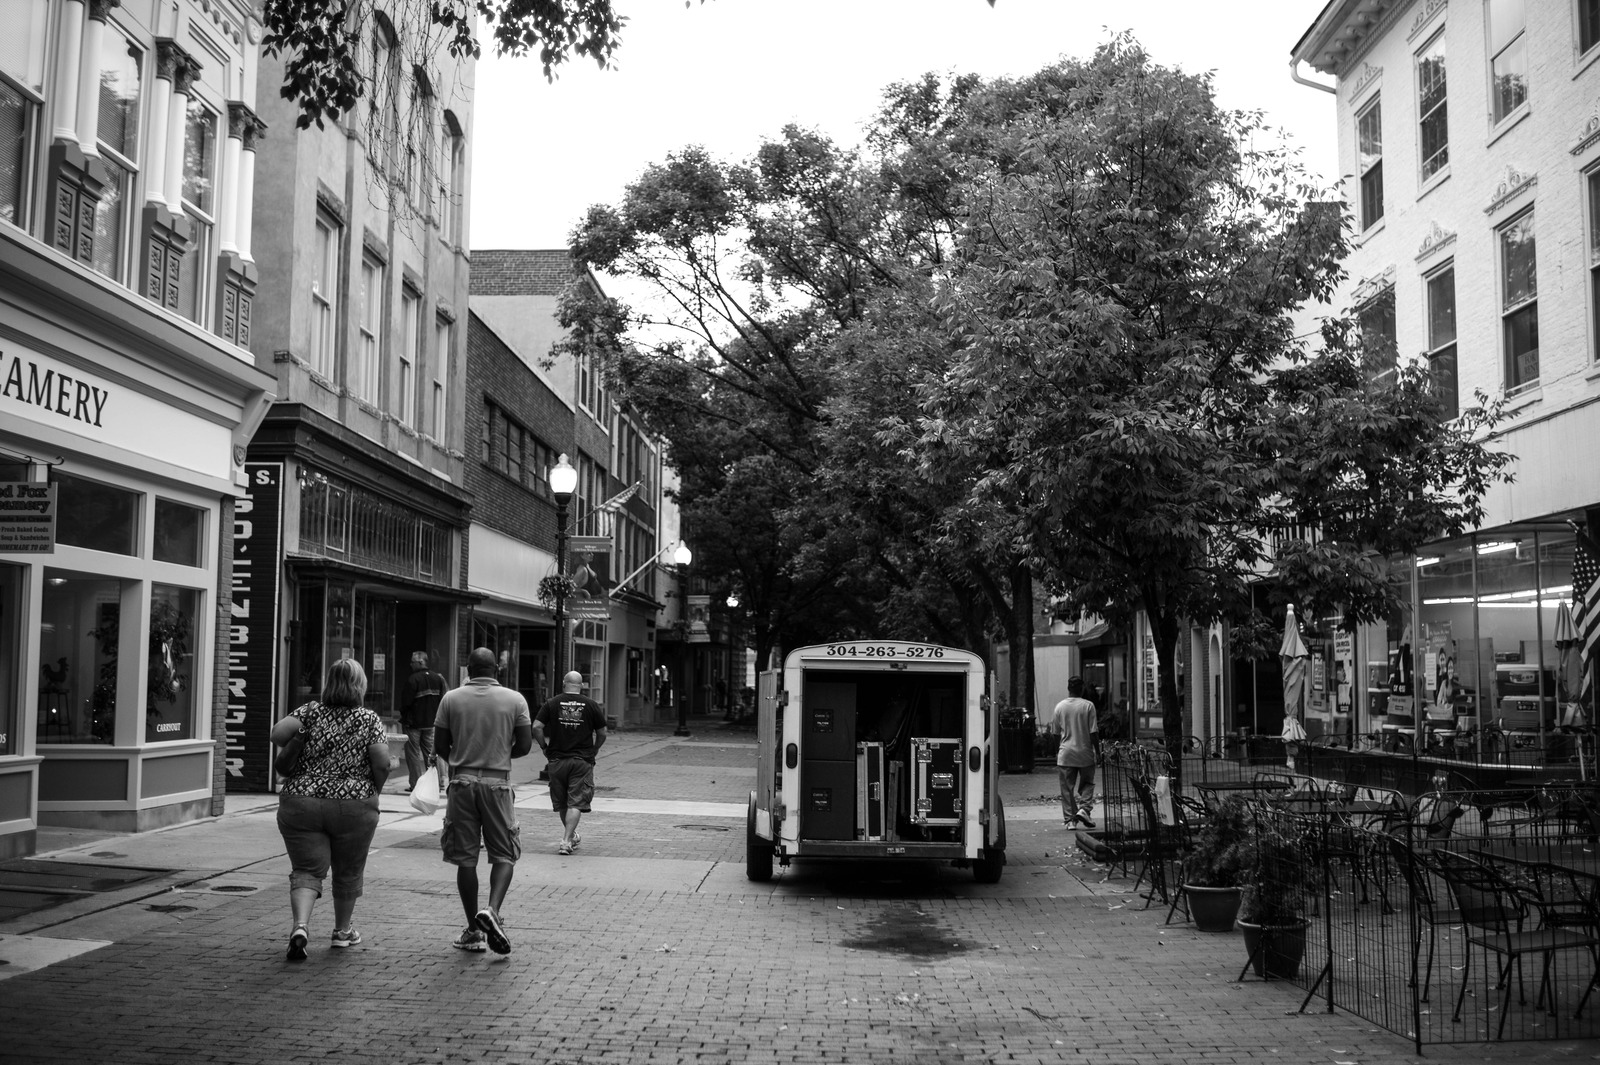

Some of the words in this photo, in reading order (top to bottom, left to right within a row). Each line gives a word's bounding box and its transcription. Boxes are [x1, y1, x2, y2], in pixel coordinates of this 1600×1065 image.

[0, 350, 108, 428] AMERY
[17, 485, 47, 498] Fox
[826, 644, 944, 658] 304-263-5276
[156, 722, 181, 732] CARRYOUT
